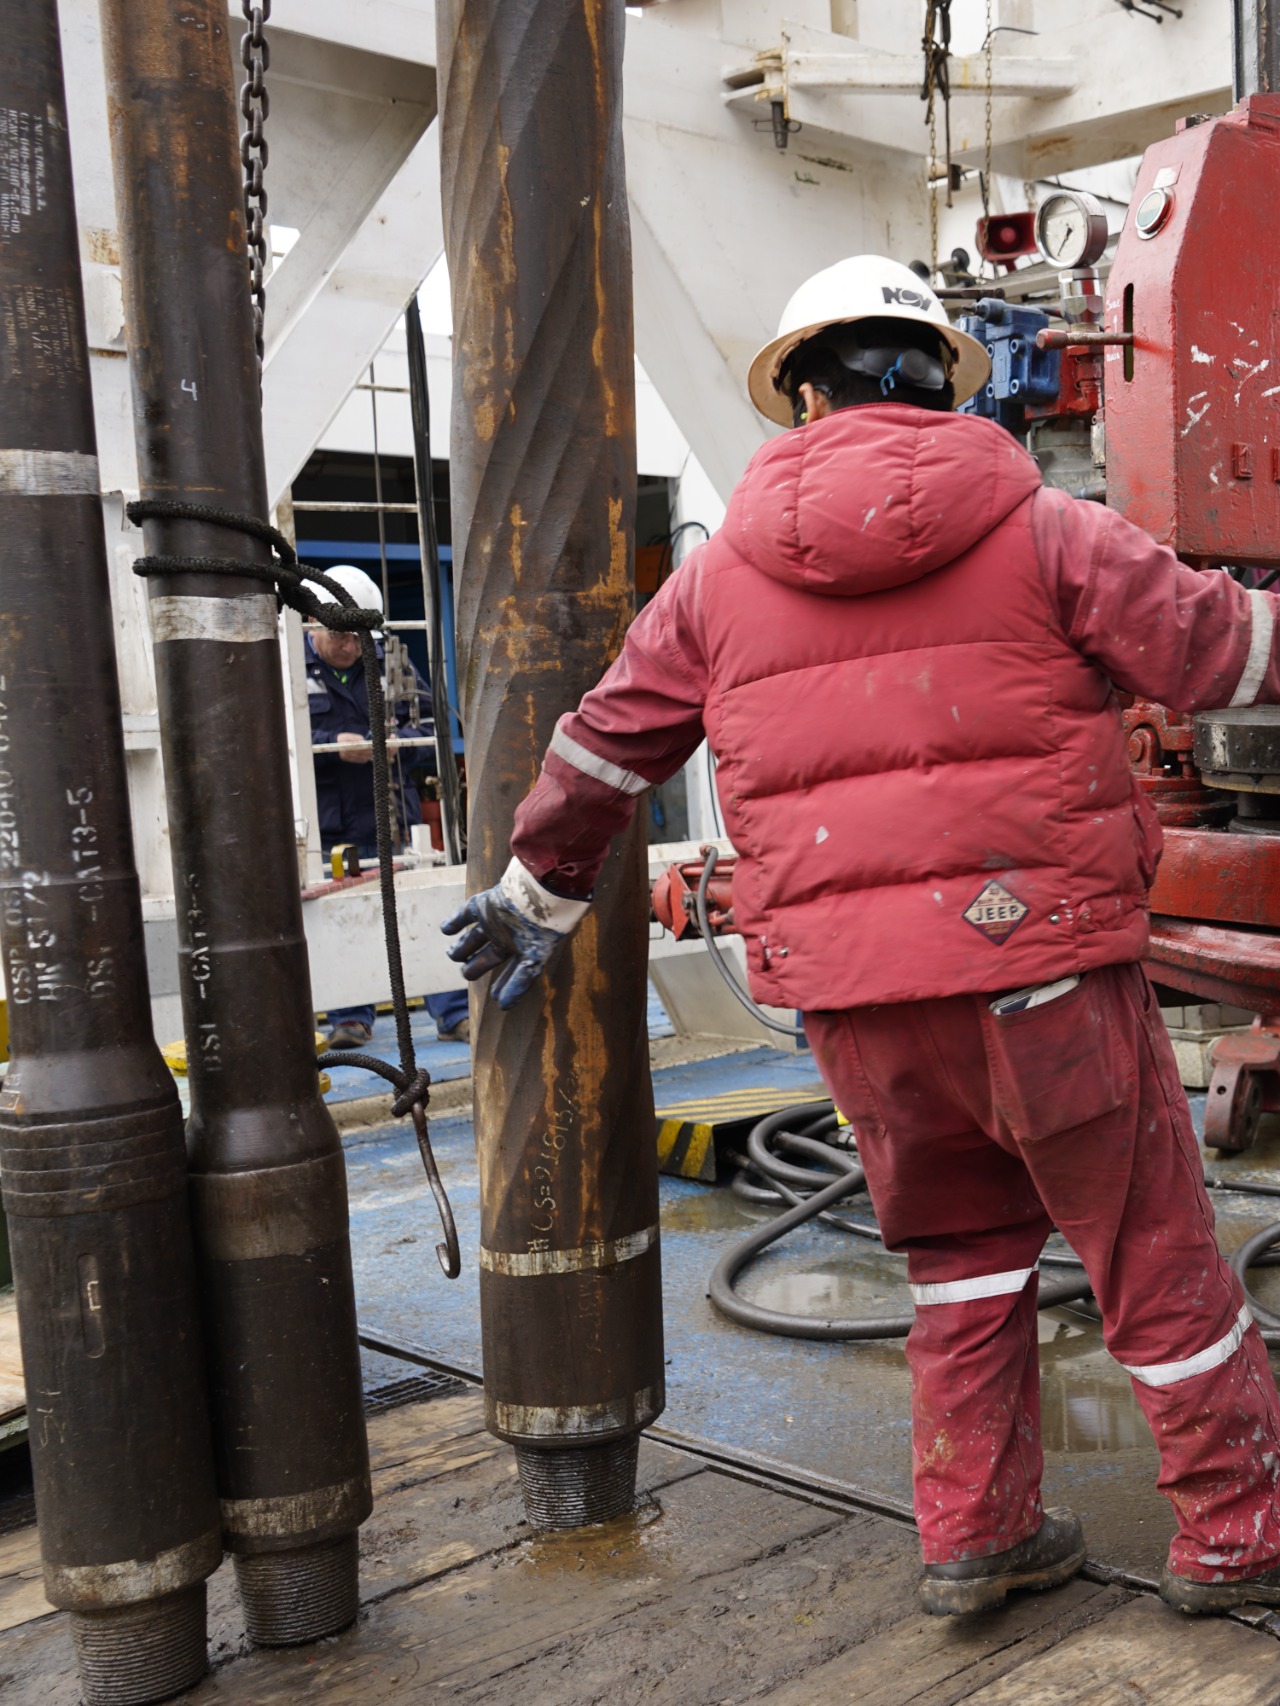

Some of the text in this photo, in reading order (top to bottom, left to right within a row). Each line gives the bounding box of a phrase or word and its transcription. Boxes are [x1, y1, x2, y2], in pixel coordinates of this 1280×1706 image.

[881, 286, 932, 312] NOV
[181, 379, 197, 401] 4
[975, 904, 1018, 921] JEEP
